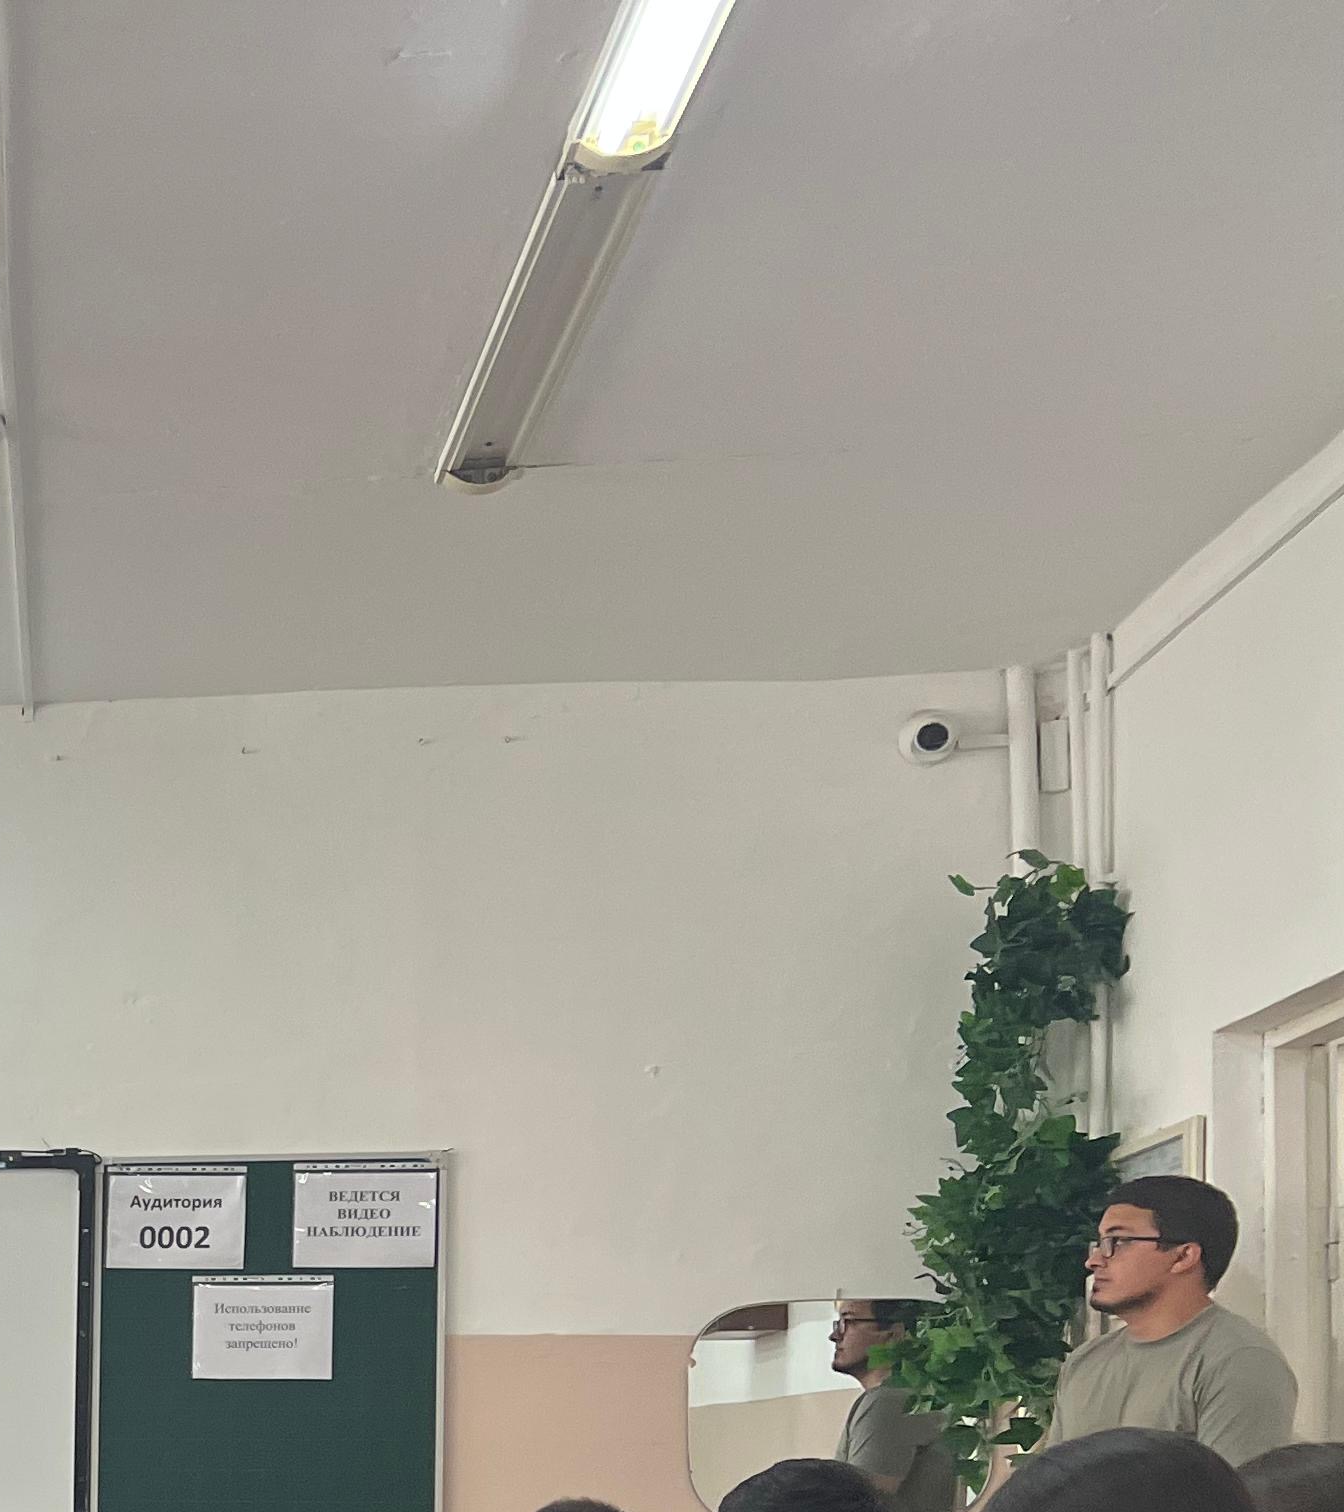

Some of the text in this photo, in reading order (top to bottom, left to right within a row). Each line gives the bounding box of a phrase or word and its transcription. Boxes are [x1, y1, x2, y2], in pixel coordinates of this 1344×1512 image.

[130, 1195, 223, 1211] Аудитория
[328, 1190, 401, 1203] ВЕДЕТСЯ
[337, 1208, 391, 1220] ВИДЕО
[139, 1226, 210, 1249] 0002
[306, 1225, 422, 1238] НАБЛЮДЕНИЕ
[214, 1303, 312, 1315] Использование
[228, 1320, 296, 1335] телефонов
[225, 1338, 297, 1352] запрещено!
